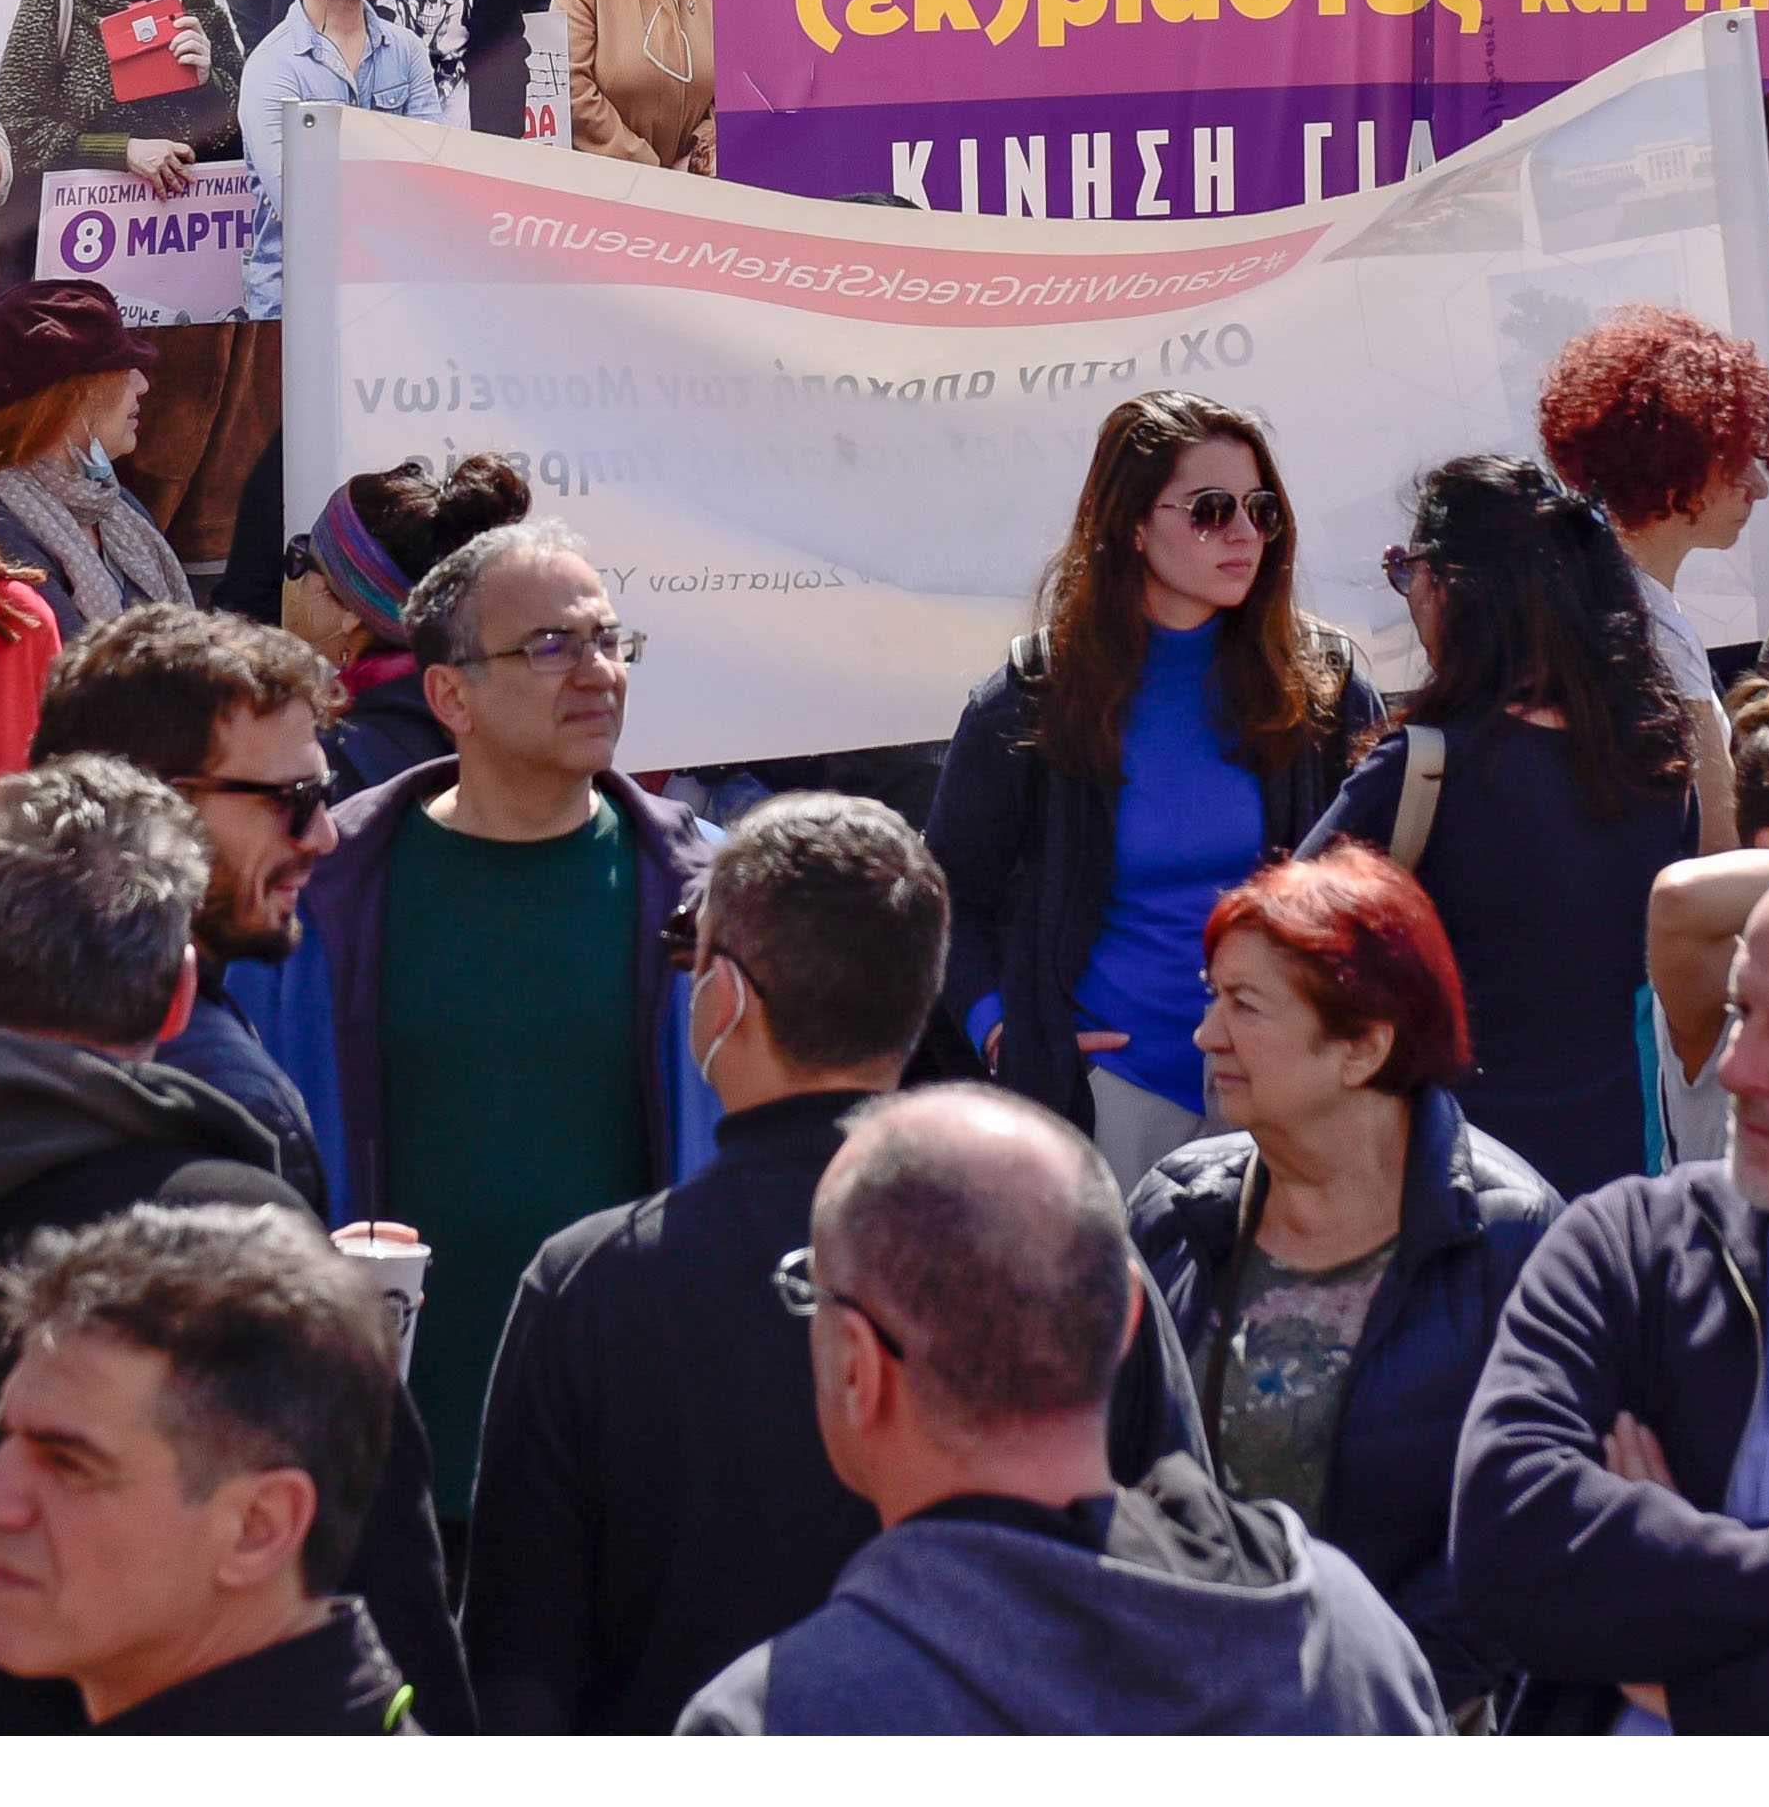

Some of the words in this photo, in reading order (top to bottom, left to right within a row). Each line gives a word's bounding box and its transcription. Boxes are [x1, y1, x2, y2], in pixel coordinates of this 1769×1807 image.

[55, 183, 147, 207] ΠΑΓΚΟΣΜΙΑ
[195, 175, 252, 198] ΓΥΝΑΙΚ
[879, 125, 1236, 219] ΚΙΝΗΣΗ
[1293, 119, 1438, 213] ΓΙΑ
[73, 217, 104, 265] 8
